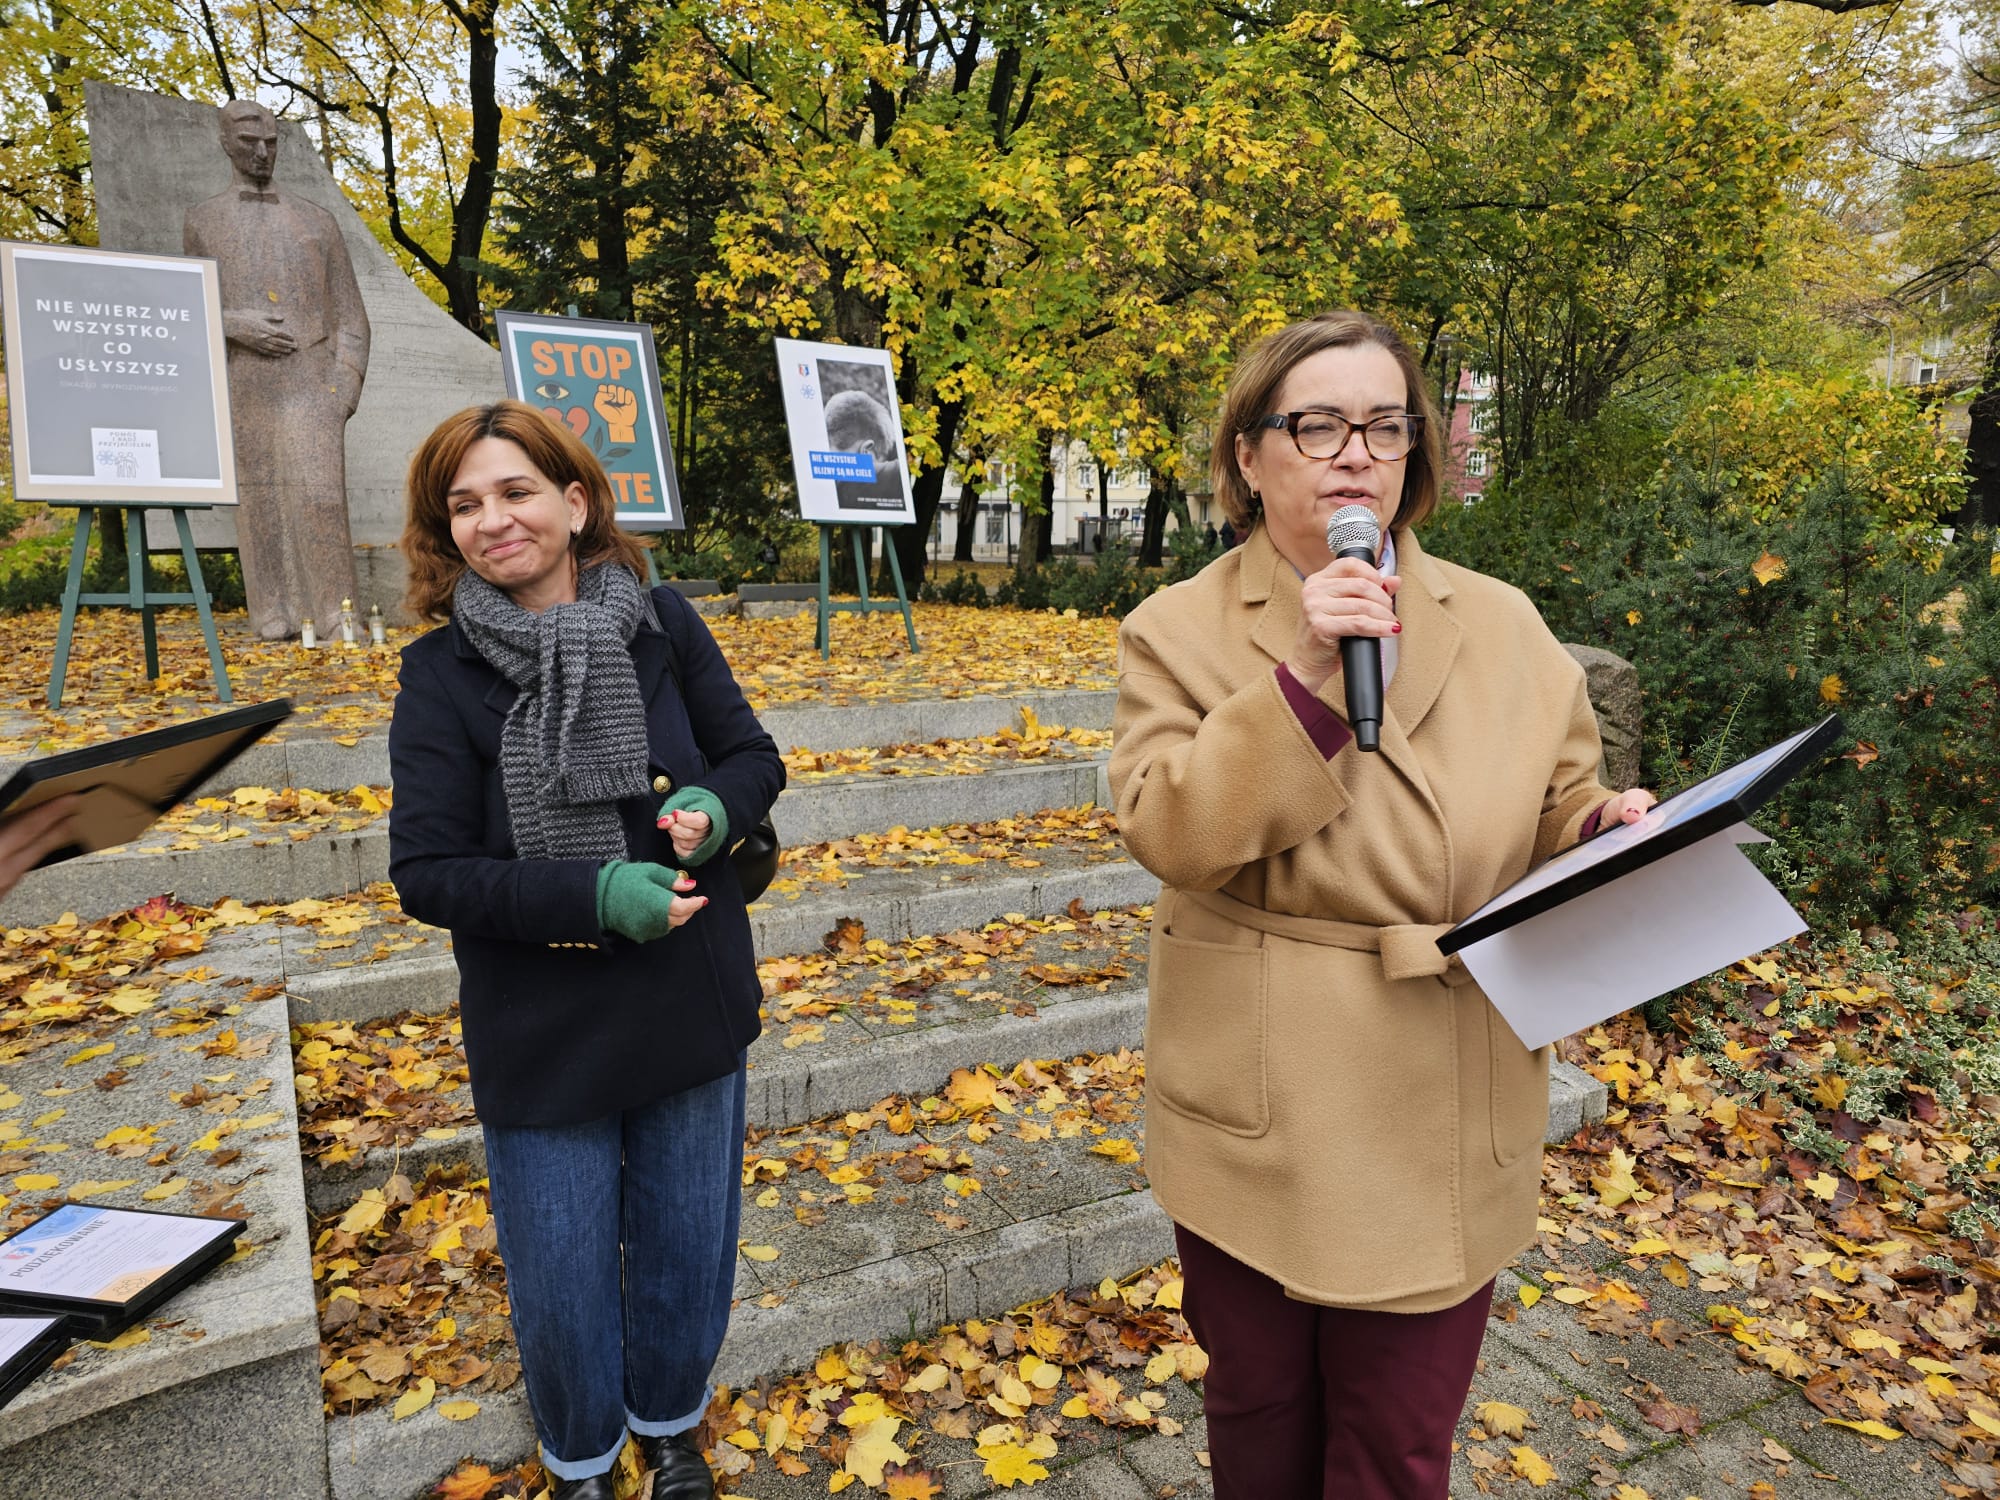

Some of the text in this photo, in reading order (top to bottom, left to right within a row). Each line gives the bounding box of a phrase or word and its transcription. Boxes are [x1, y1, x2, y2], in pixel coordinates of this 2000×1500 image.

[36, 299, 191, 322] NIE WIERZ WE
[53, 319, 177, 341] WSZYSTKO,
[103, 341, 132, 355] CO
[58, 357, 180, 376] USŁYSZYSZ
[531, 340, 632, 380] STOP
[811, 454, 822, 462] NIE
[9, 1219, 109, 1278] PODZIĘKOWANIE
